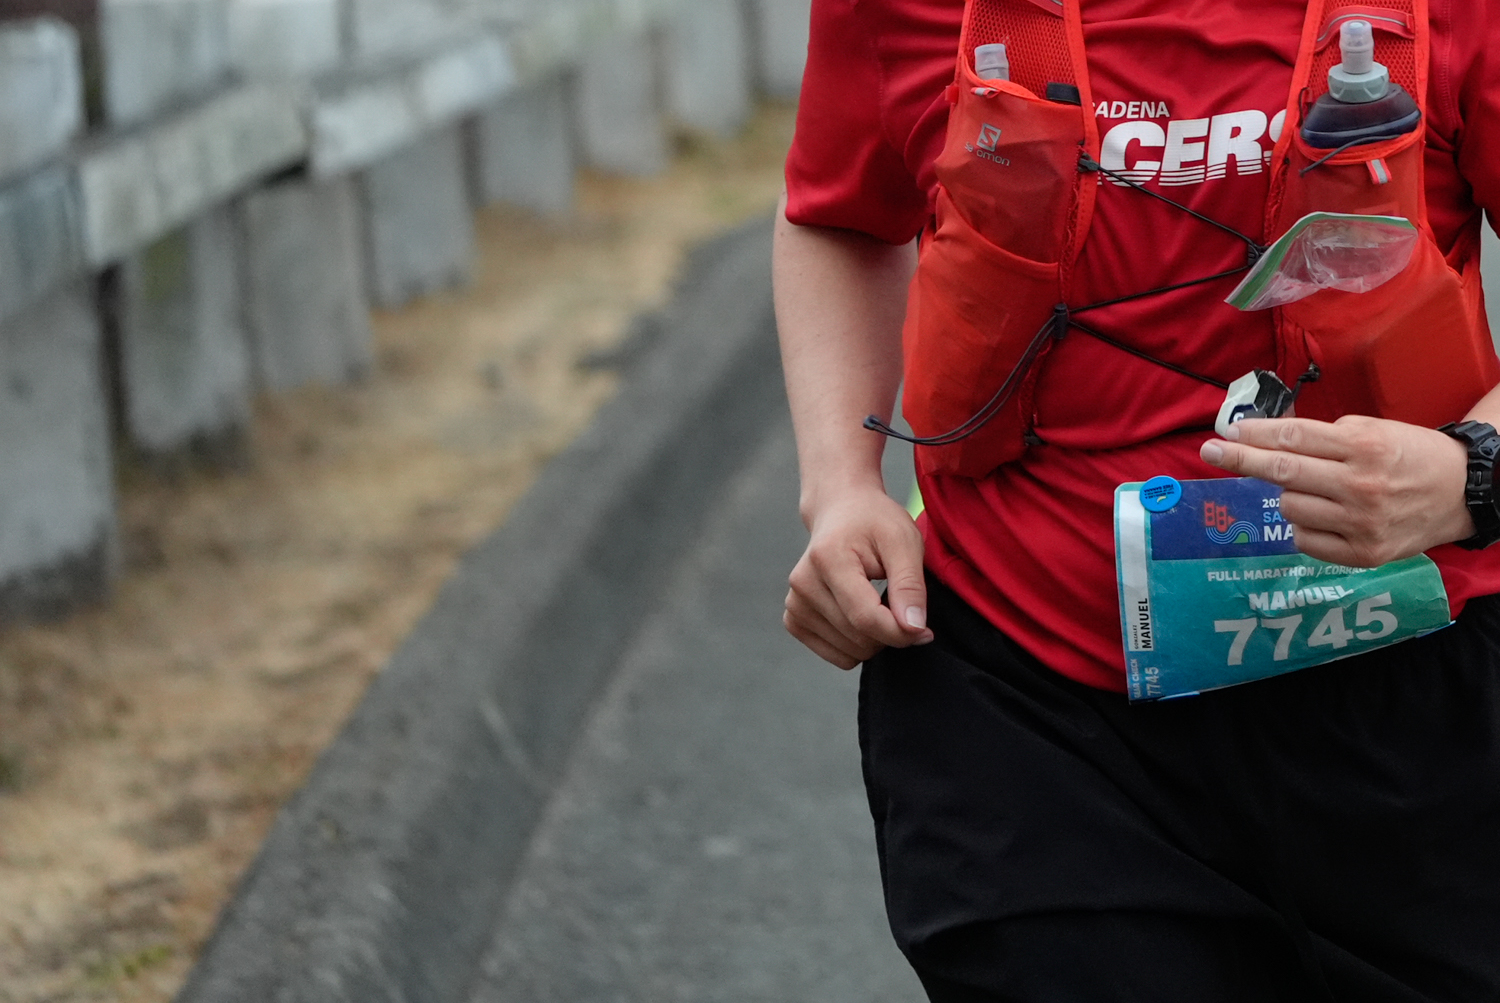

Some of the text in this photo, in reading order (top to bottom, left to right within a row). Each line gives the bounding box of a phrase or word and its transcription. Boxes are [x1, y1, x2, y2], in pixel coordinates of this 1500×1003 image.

[1092, 101, 1170, 118] ADENA
[1098, 109, 1287, 187] CER
[1262, 498, 1280, 508] 202
[1263, 511, 1286, 523] SA
[1263, 524, 1293, 542] MA
[1207, 571, 1240, 582] FULL
[1244, 566, 1314, 581] MARATHON
[1249, 585, 1354, 611] MANUEL
[1138, 598, 1152, 649] MANUEL
[1214, 591, 1398, 666] 7745
[1130, 658, 1140, 682] CHECK
[1144, 666, 1161, 696] 7745
